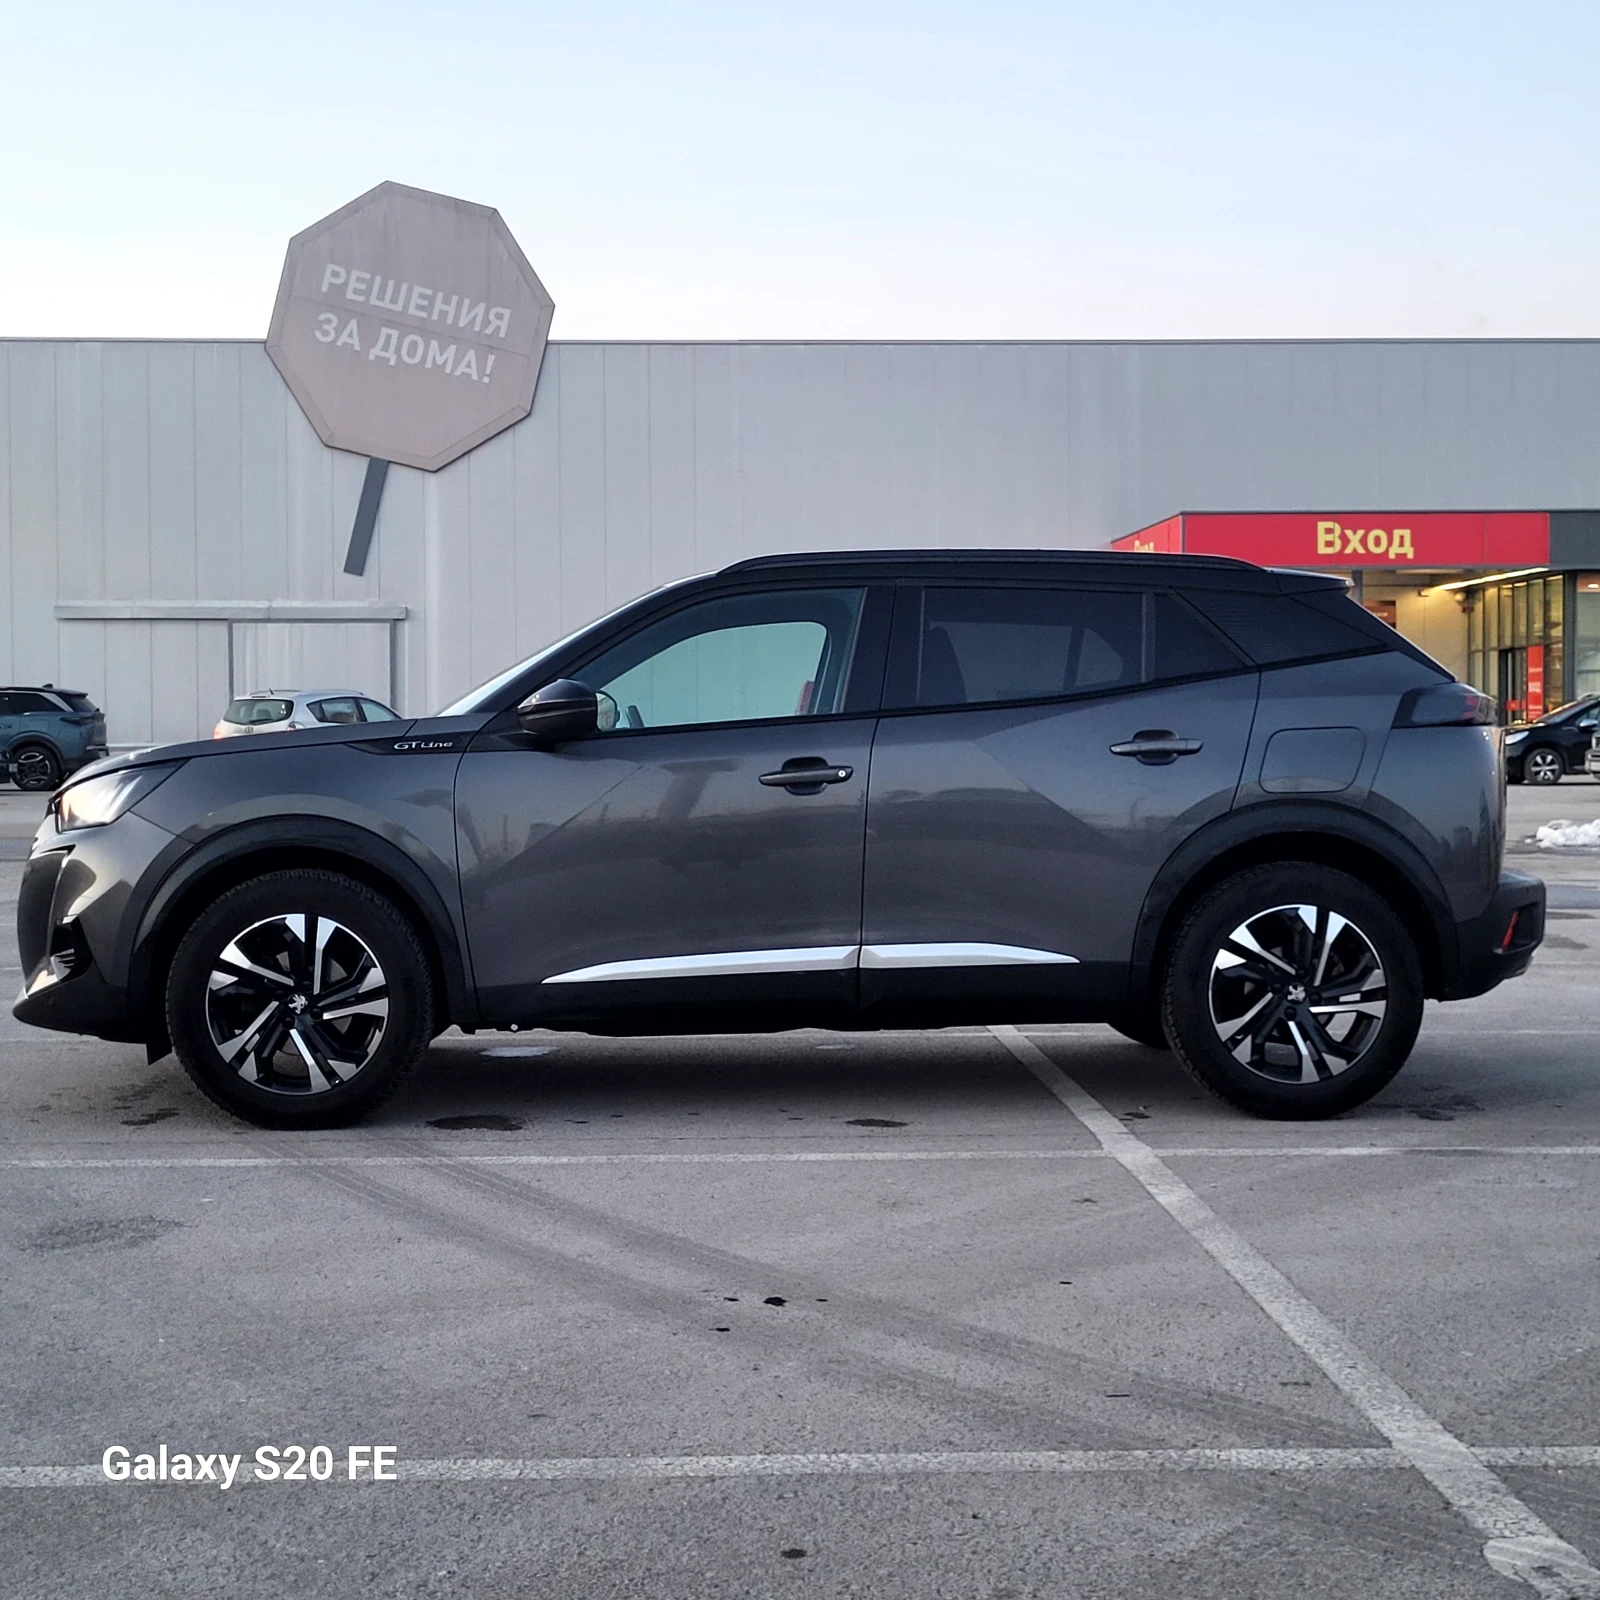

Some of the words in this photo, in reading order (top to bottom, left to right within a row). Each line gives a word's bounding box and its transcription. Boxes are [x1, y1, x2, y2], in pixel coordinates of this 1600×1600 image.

[321, 263, 512, 338] РЕШЕНИЯ
[314, 312, 361, 351] ЗА
[368, 326, 496, 384] ДОМА!
[1316, 521, 1414, 559] Вход
[393, 741, 421, 750] GT
[420, 741, 453, 749] Line
